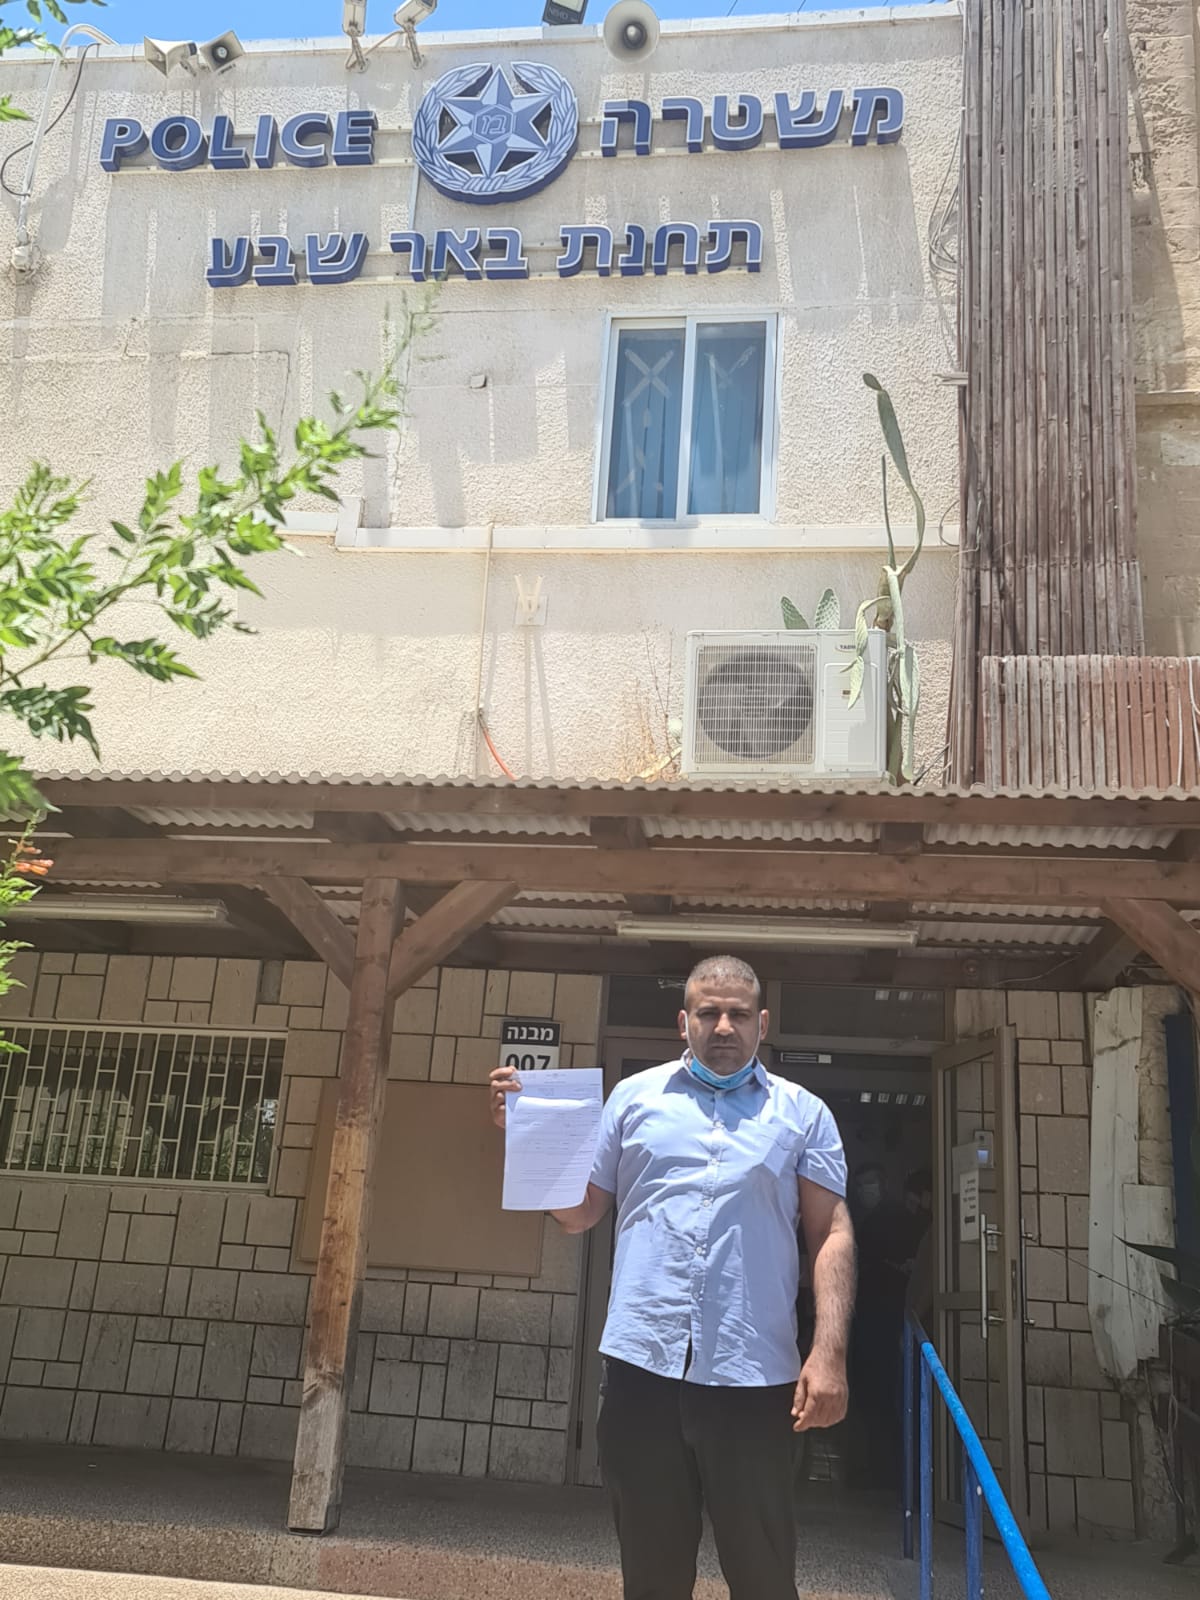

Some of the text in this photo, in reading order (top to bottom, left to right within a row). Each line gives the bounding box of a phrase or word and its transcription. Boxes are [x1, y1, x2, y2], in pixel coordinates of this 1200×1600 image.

[100, 110, 378, 171] POLICE
[600, 86, 904, 157] משטרה
[205, 219, 763, 288] תחנת באר שבע
[505, 1053, 551, 1070] 007
[507, 1026, 554, 1041] מבנה
